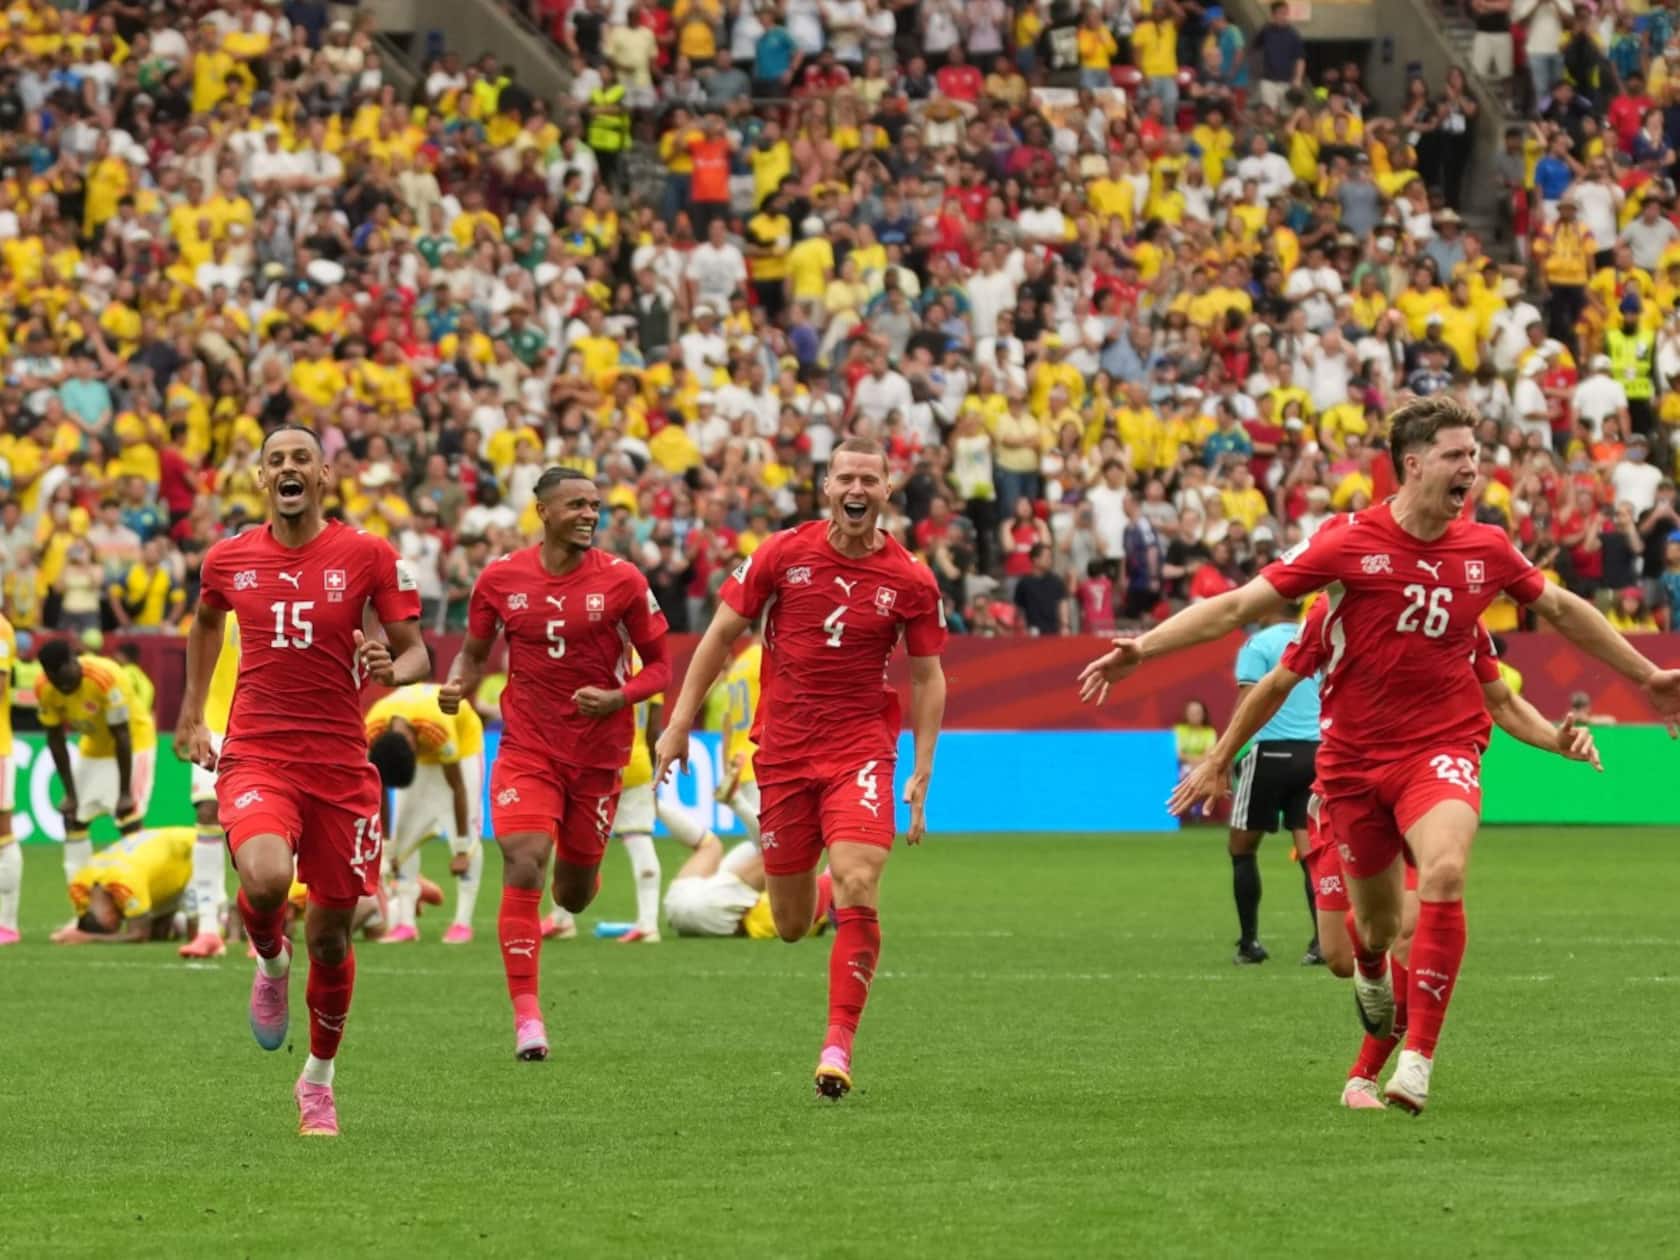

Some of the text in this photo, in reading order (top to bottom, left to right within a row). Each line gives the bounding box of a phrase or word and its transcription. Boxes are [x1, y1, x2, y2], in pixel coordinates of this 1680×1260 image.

[270, 601, 314, 649] 15
[823, 605, 848, 648] 4
[1396, 584, 1453, 637] 26
[546, 620, 565, 659] 5
[856, 760, 878, 799] 4
